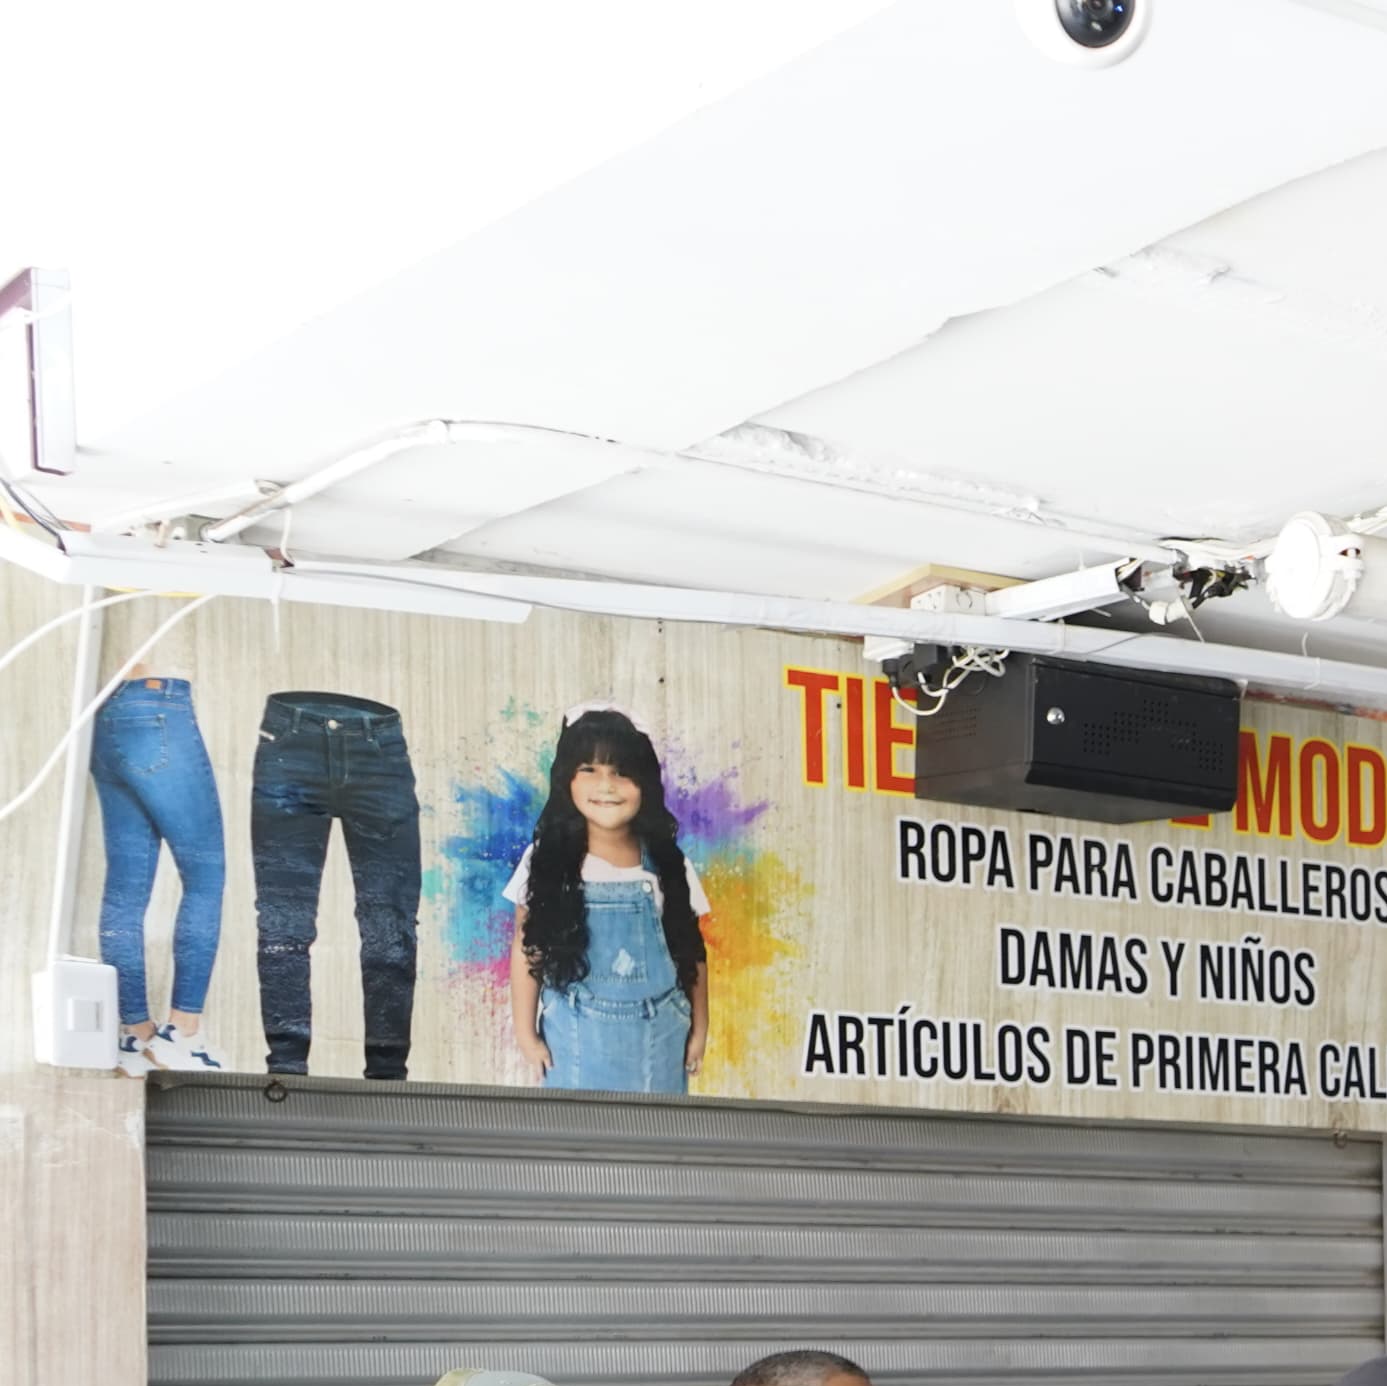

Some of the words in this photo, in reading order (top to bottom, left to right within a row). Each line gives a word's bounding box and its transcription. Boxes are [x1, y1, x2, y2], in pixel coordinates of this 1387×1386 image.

[900, 820, 1014, 888] ROPA
[1029, 834, 1137, 900] PARA
[1000, 928, 1148, 994] DAMAS
[1161, 941, 1185, 996] Y
[1200, 936, 1315, 1006] NIÑOS
[805, 1006, 1050, 1084] ARTÍCULOS
[1066, 1028, 1118, 1086] DE
[1131, 1032, 1307, 1096] PRIMERA
